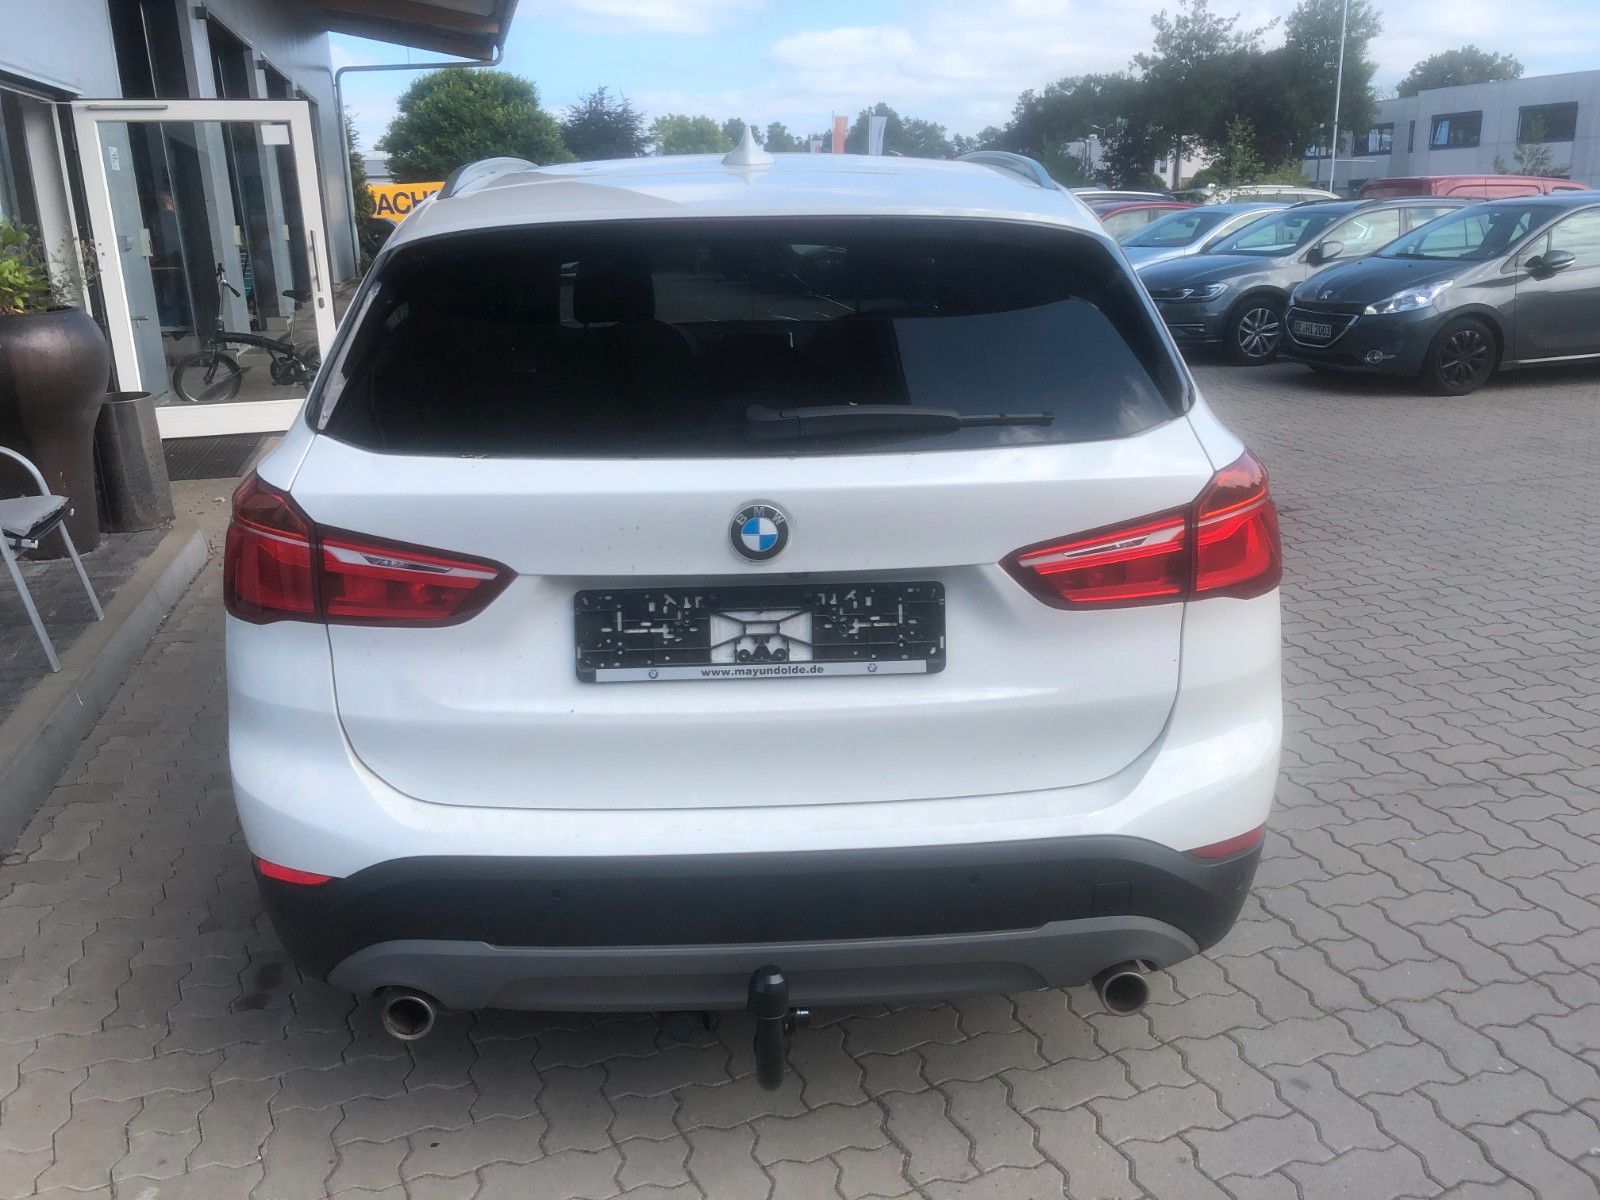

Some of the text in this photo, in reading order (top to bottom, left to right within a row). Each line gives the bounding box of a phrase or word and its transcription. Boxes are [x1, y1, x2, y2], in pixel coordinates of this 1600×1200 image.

[368, 190, 436, 216] ACH
[735, 506, 785, 526] BMW
[701, 665, 824, 677] www.mayundolde.de
